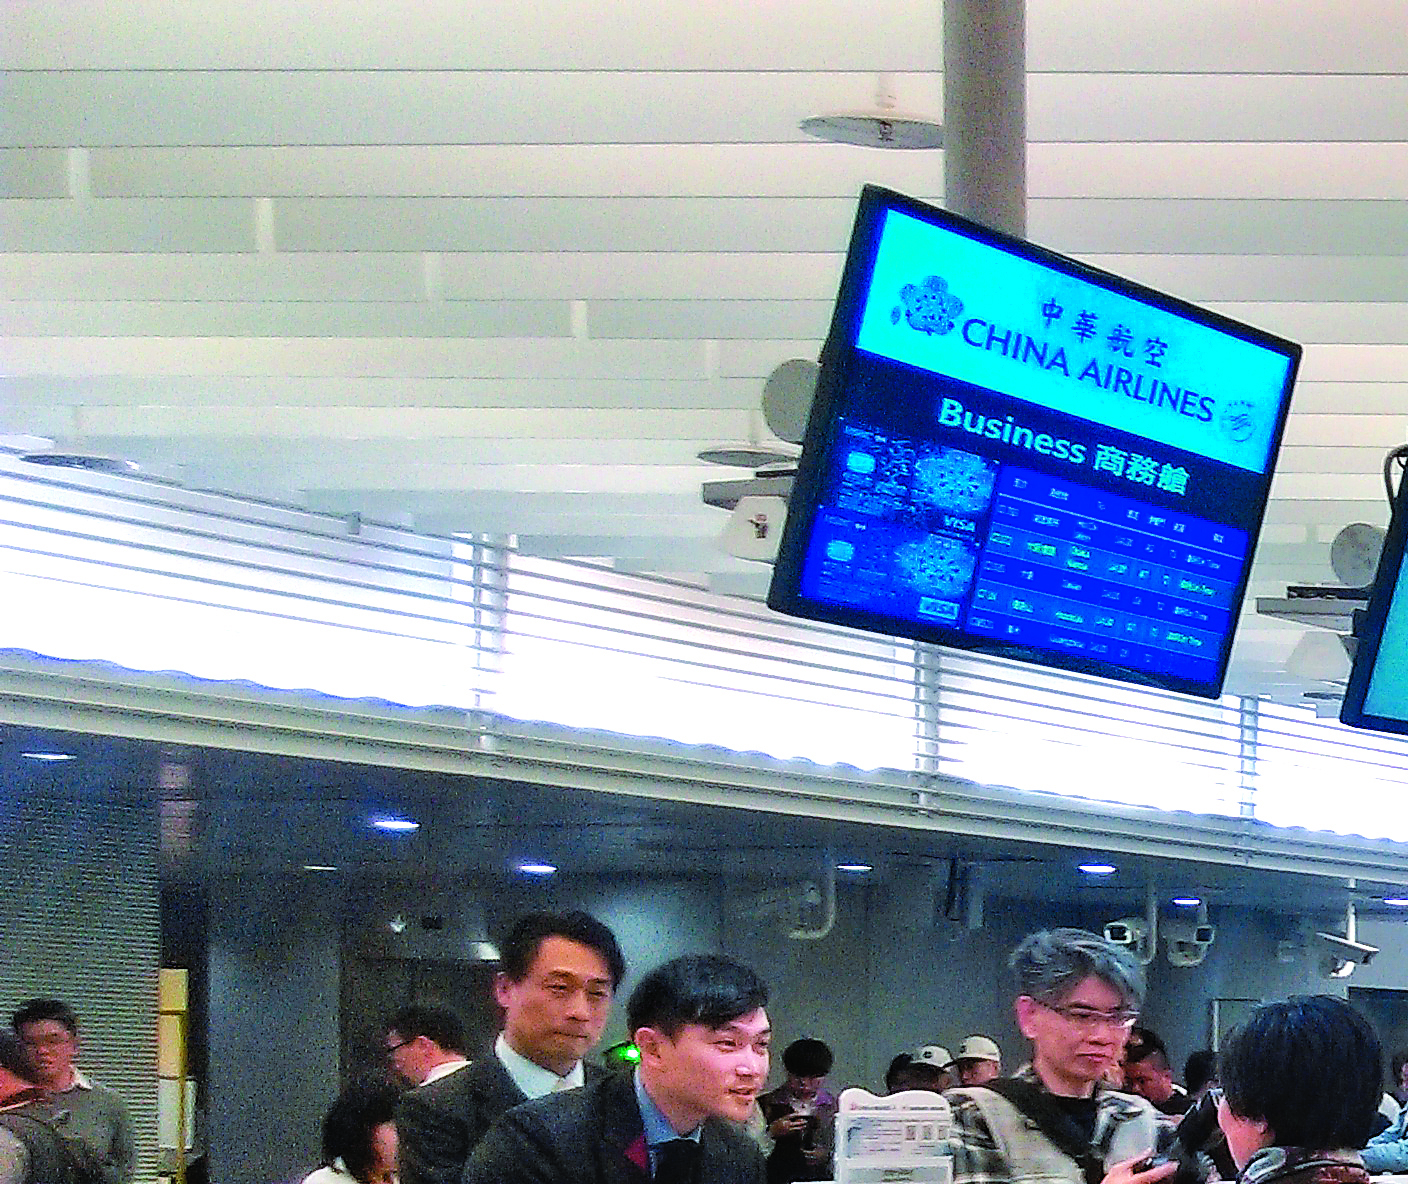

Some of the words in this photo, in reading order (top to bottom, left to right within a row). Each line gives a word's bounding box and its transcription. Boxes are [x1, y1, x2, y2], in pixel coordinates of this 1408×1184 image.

[962, 317, 1070, 378] CHINA
[1078, 358, 1216, 423] AIRLINES
[1041, 297, 1168, 368] 中華航空
[937, 397, 1087, 465] Business
[1093, 443, 1191, 497] 商務艙
